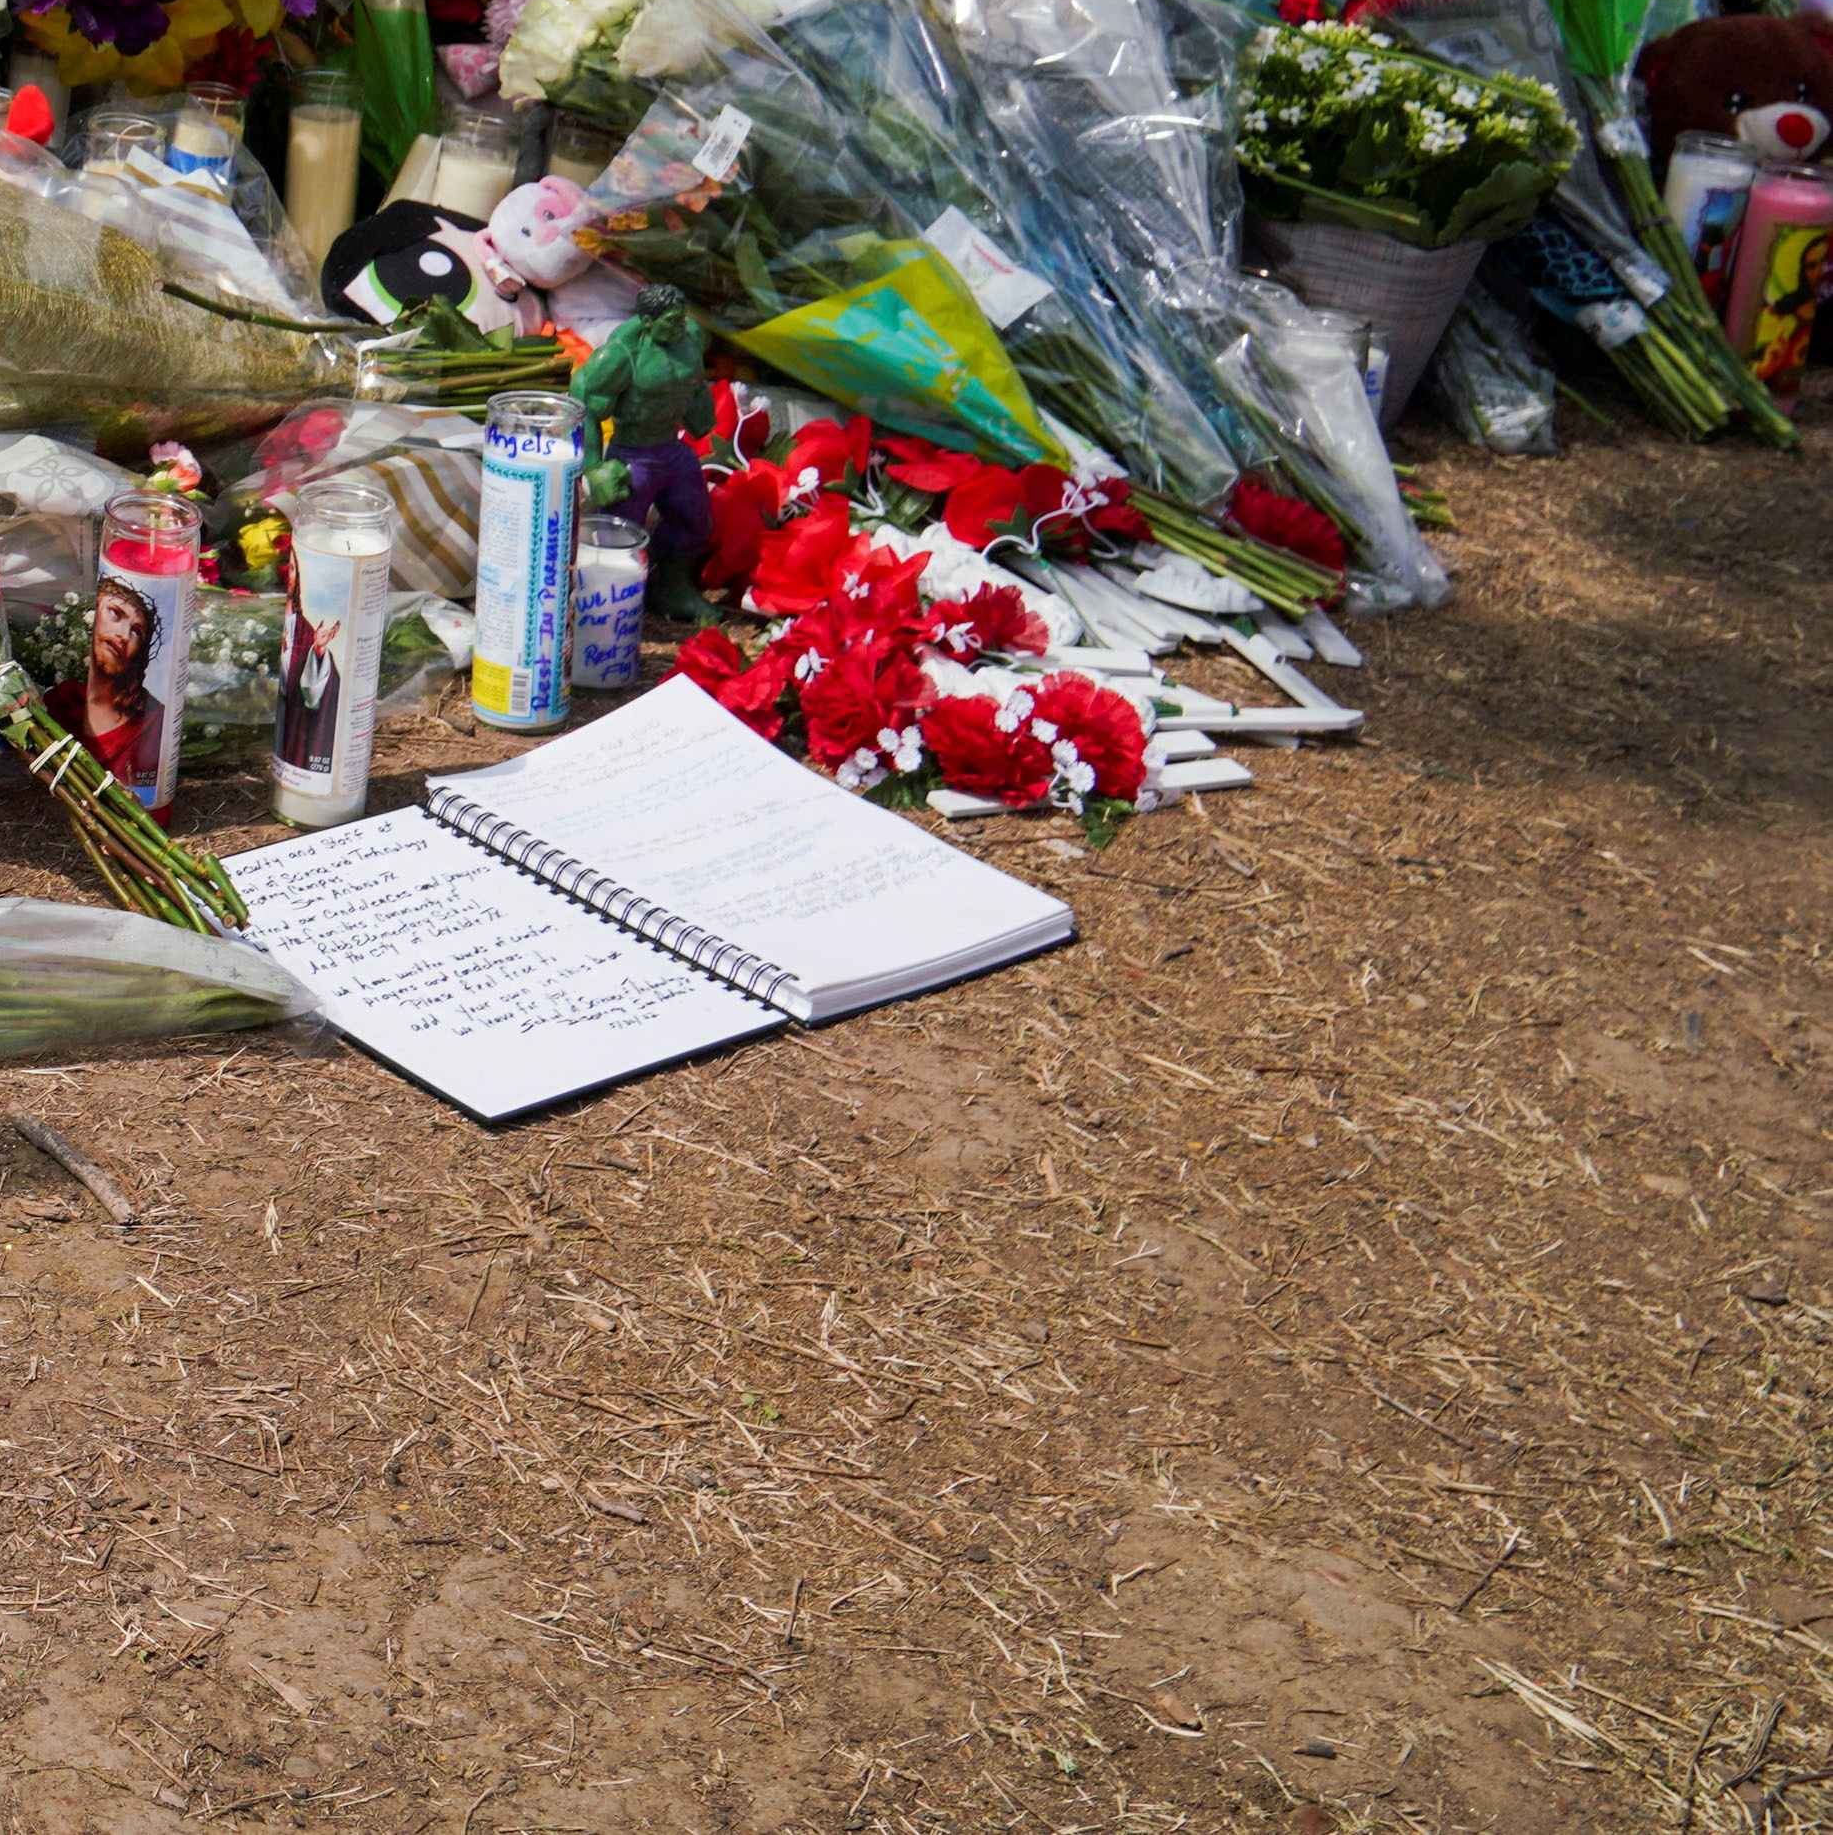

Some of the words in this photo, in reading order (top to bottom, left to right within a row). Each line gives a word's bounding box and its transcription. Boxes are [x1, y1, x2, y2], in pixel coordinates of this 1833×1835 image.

[485, 424, 557, 459] Angels
[529, 655, 553, 711] Rest
[288, 846, 317, 860] and
[410, 1013, 441, 1033] add
